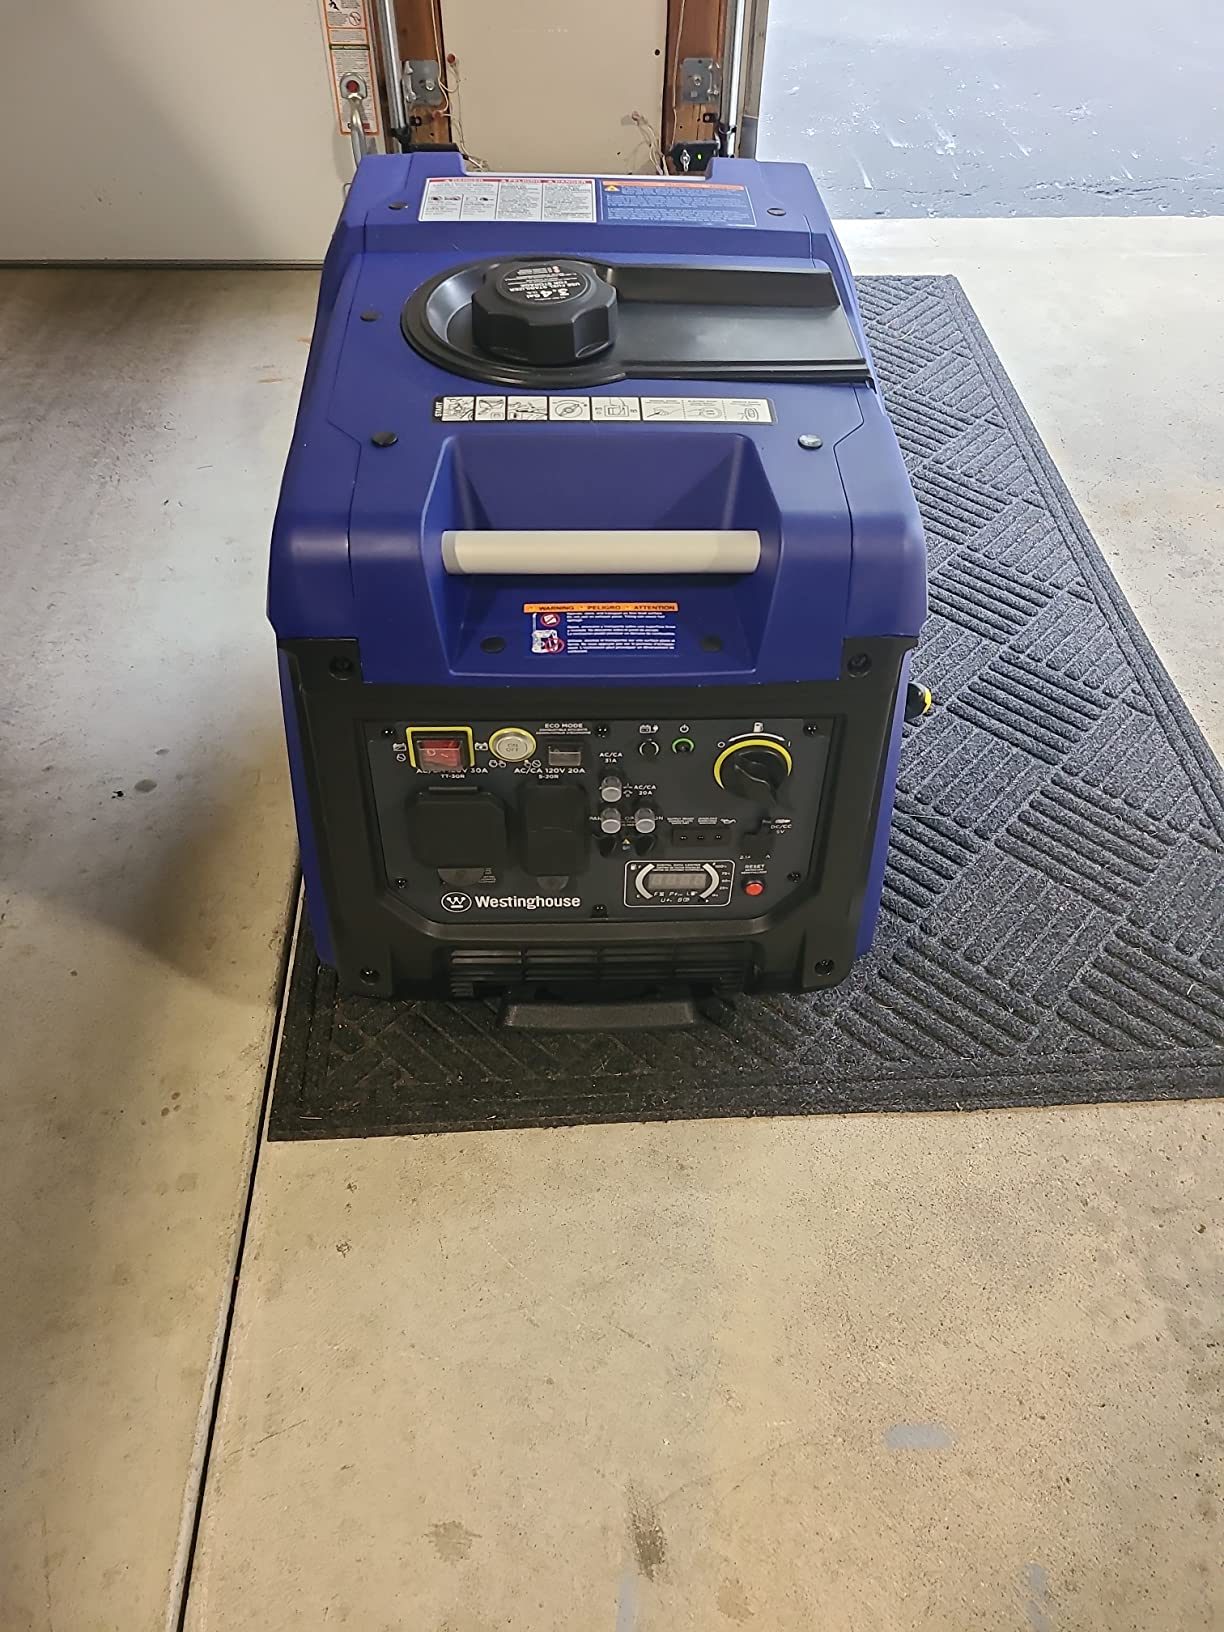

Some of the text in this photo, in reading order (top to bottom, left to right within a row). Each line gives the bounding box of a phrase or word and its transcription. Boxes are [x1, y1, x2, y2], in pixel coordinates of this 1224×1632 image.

[540, 288, 570, 298] 3.4
[435, 401, 443, 417] START
[474, 895, 581, 910] Westinghouse
